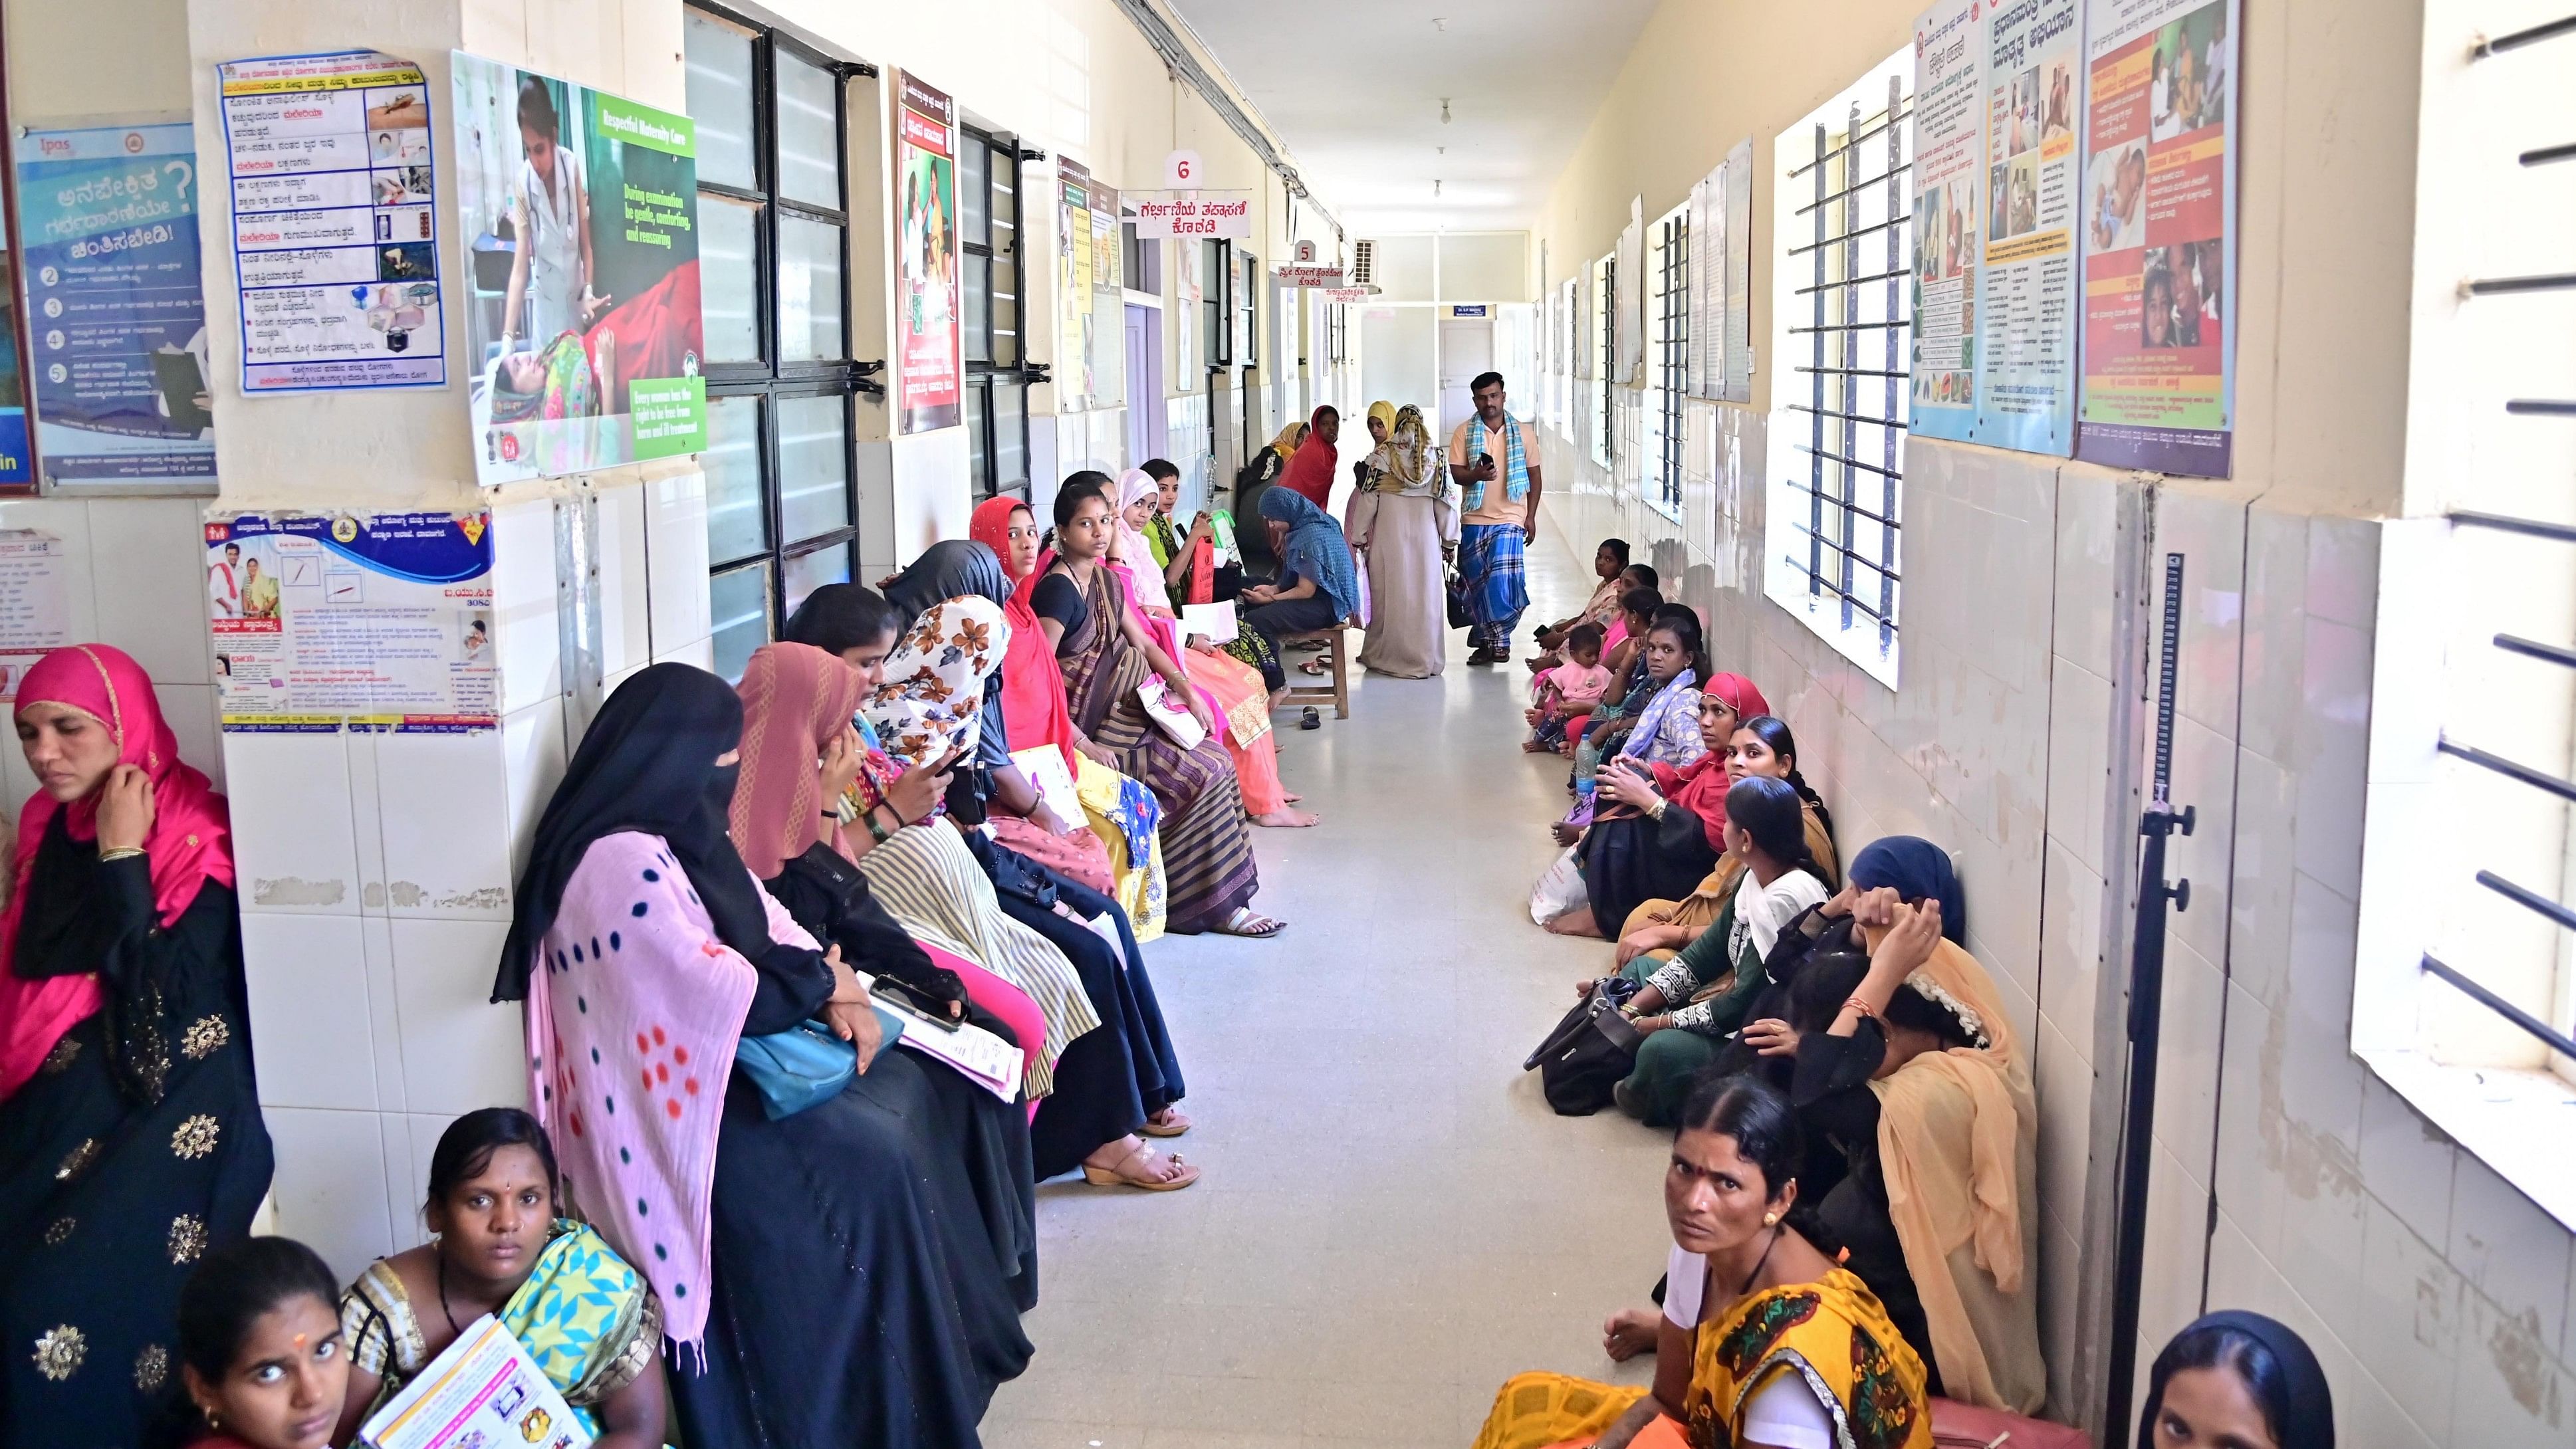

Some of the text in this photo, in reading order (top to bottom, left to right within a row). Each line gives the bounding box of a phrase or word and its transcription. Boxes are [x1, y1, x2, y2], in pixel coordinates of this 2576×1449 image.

[604, 109, 685, 146] Respectful Maternity Care
[1178, 161, 1189, 179] 6
[58, 167, 158, 207] ಅನಪೇಕ್ಷಿತ
[624, 183, 683, 209] During examination
[625, 202, 691, 231] be gentle, comforting,
[1201, 200, 1246, 217] ತಪಾಸಣೆ
[626, 225, 671, 249] and reassuring
[1301, 247, 1309, 261] 5
[635, 390, 649, 406] Every
[636, 407, 649, 425] right
[638, 425, 651, 439] harm
[653, 422, 663, 437] and
